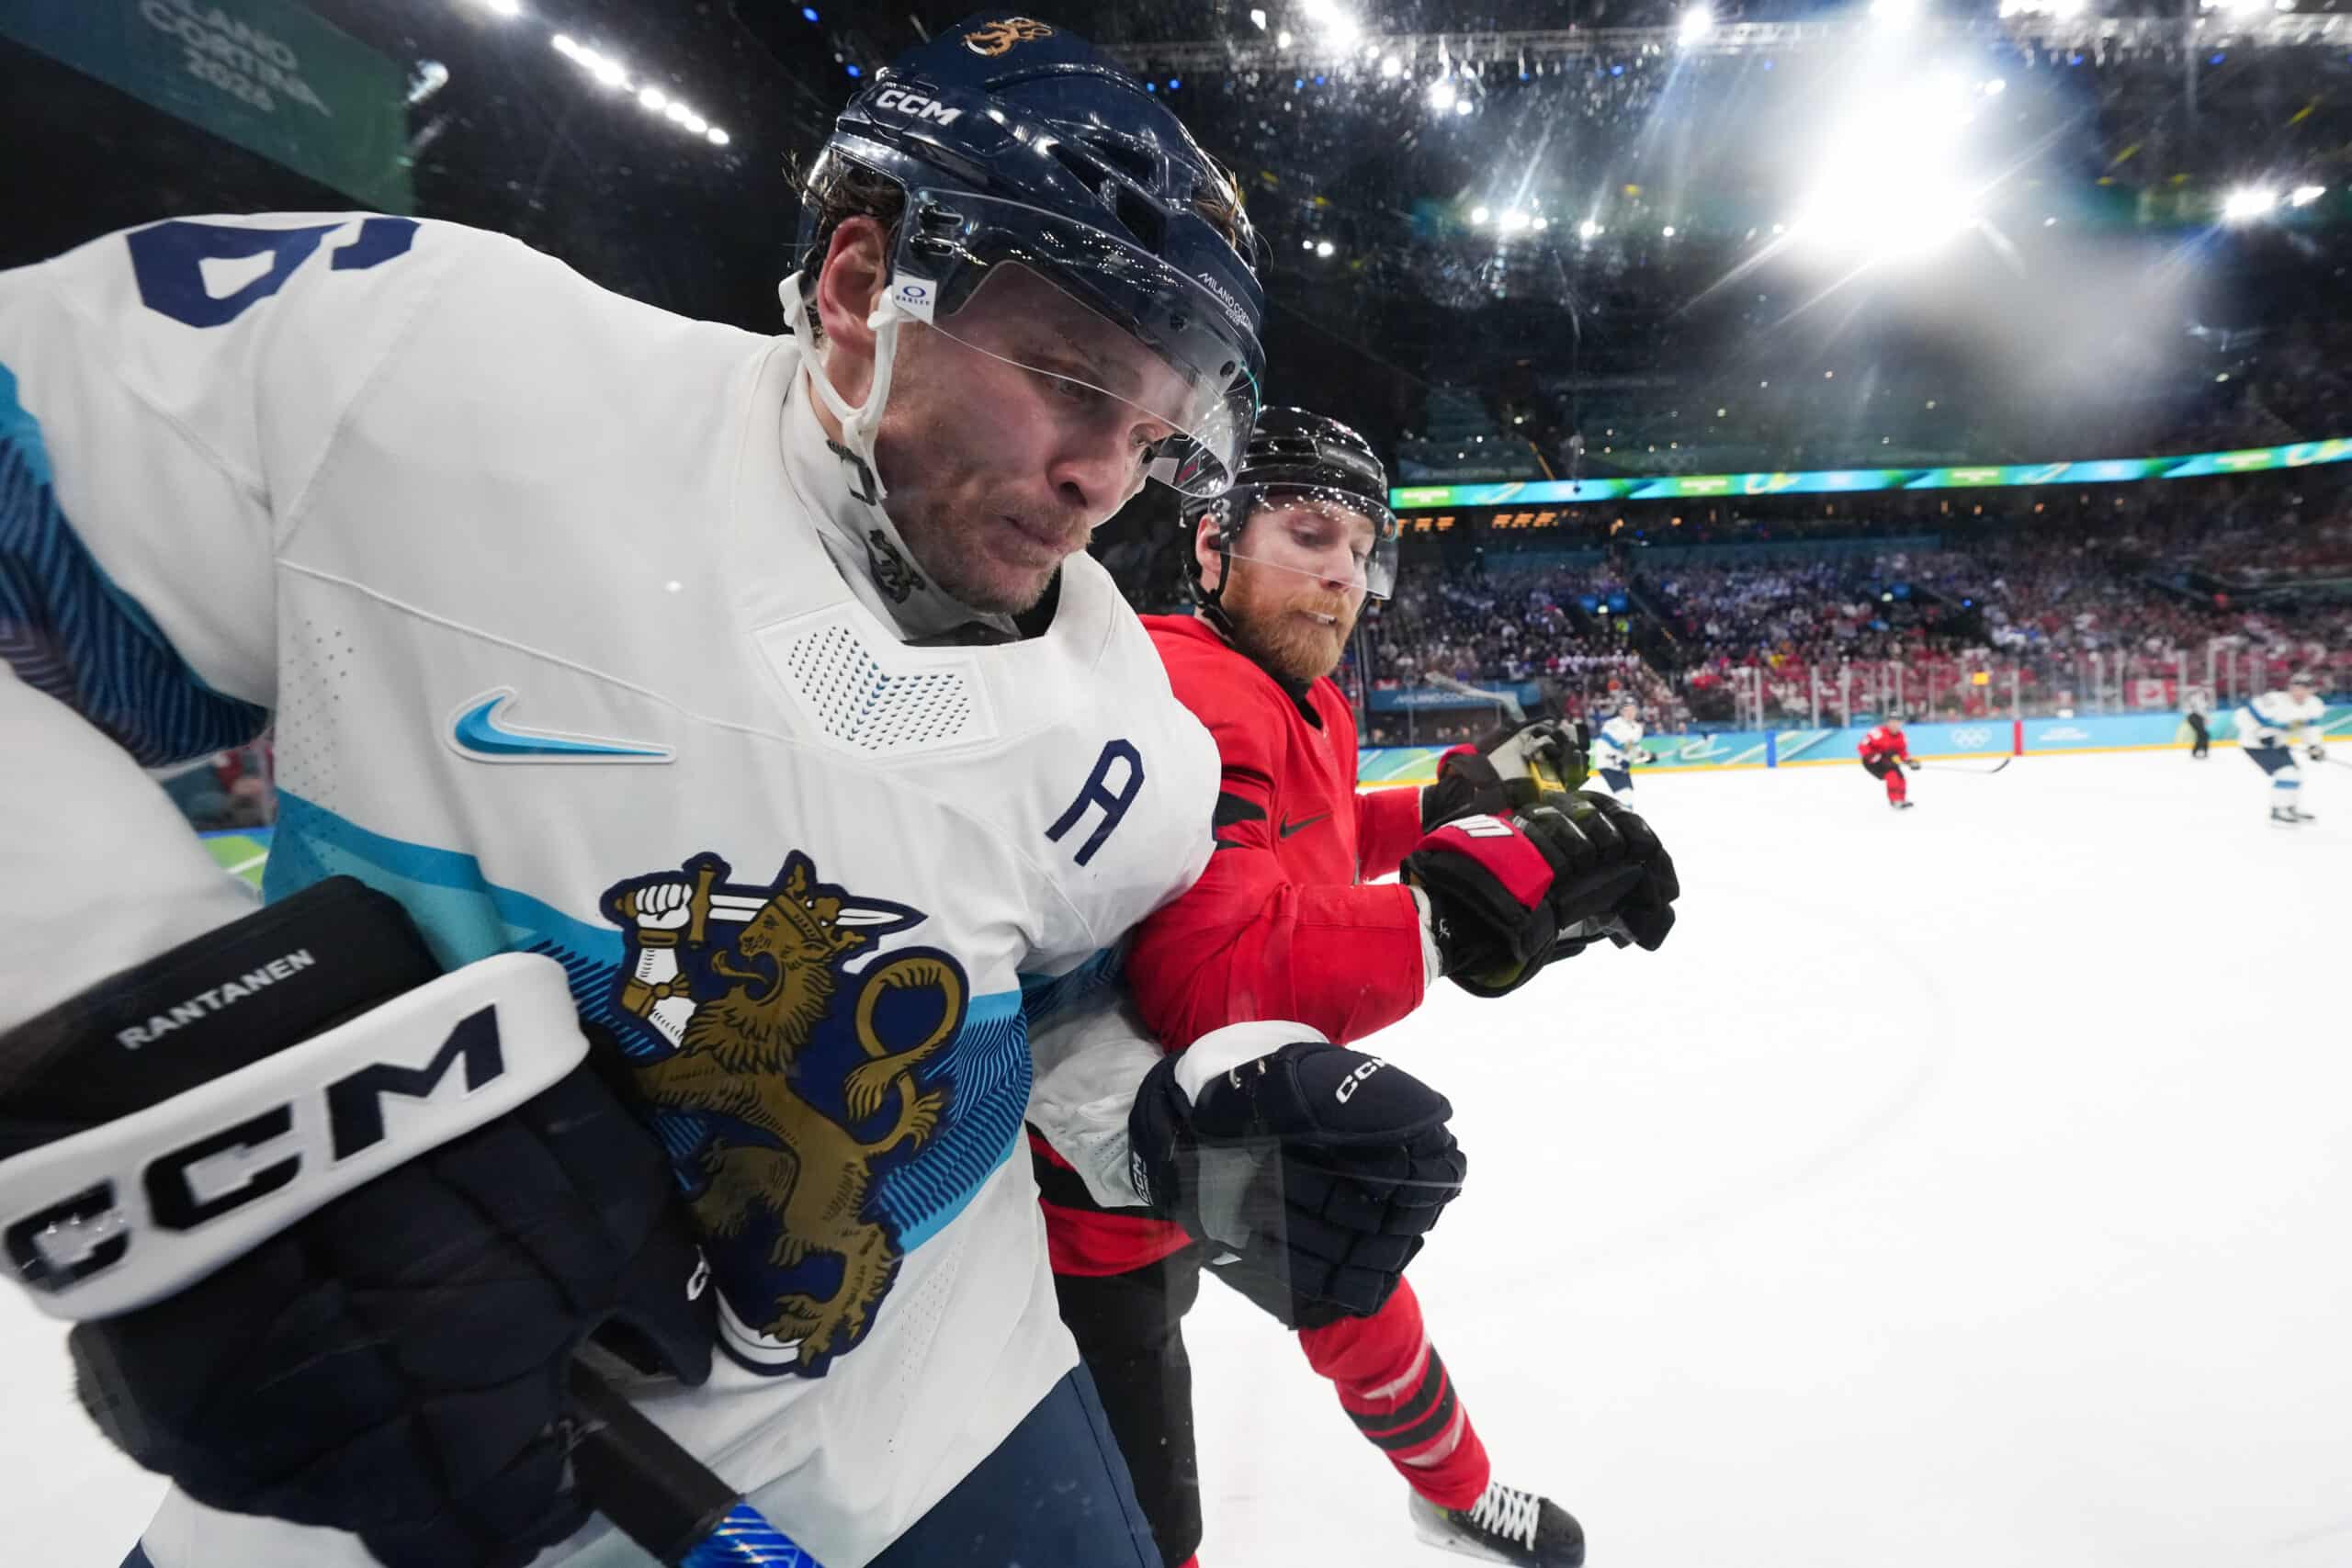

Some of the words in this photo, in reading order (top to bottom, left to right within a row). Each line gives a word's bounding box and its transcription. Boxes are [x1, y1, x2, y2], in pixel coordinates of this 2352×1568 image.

[876, 89, 962, 126] CCM
[1197, 272, 1235, 307] MILANO
[1045, 739, 1145, 867] A
[116, 947, 316, 1051] RANTANEN
[2, 1002, 505, 1294] CCM
